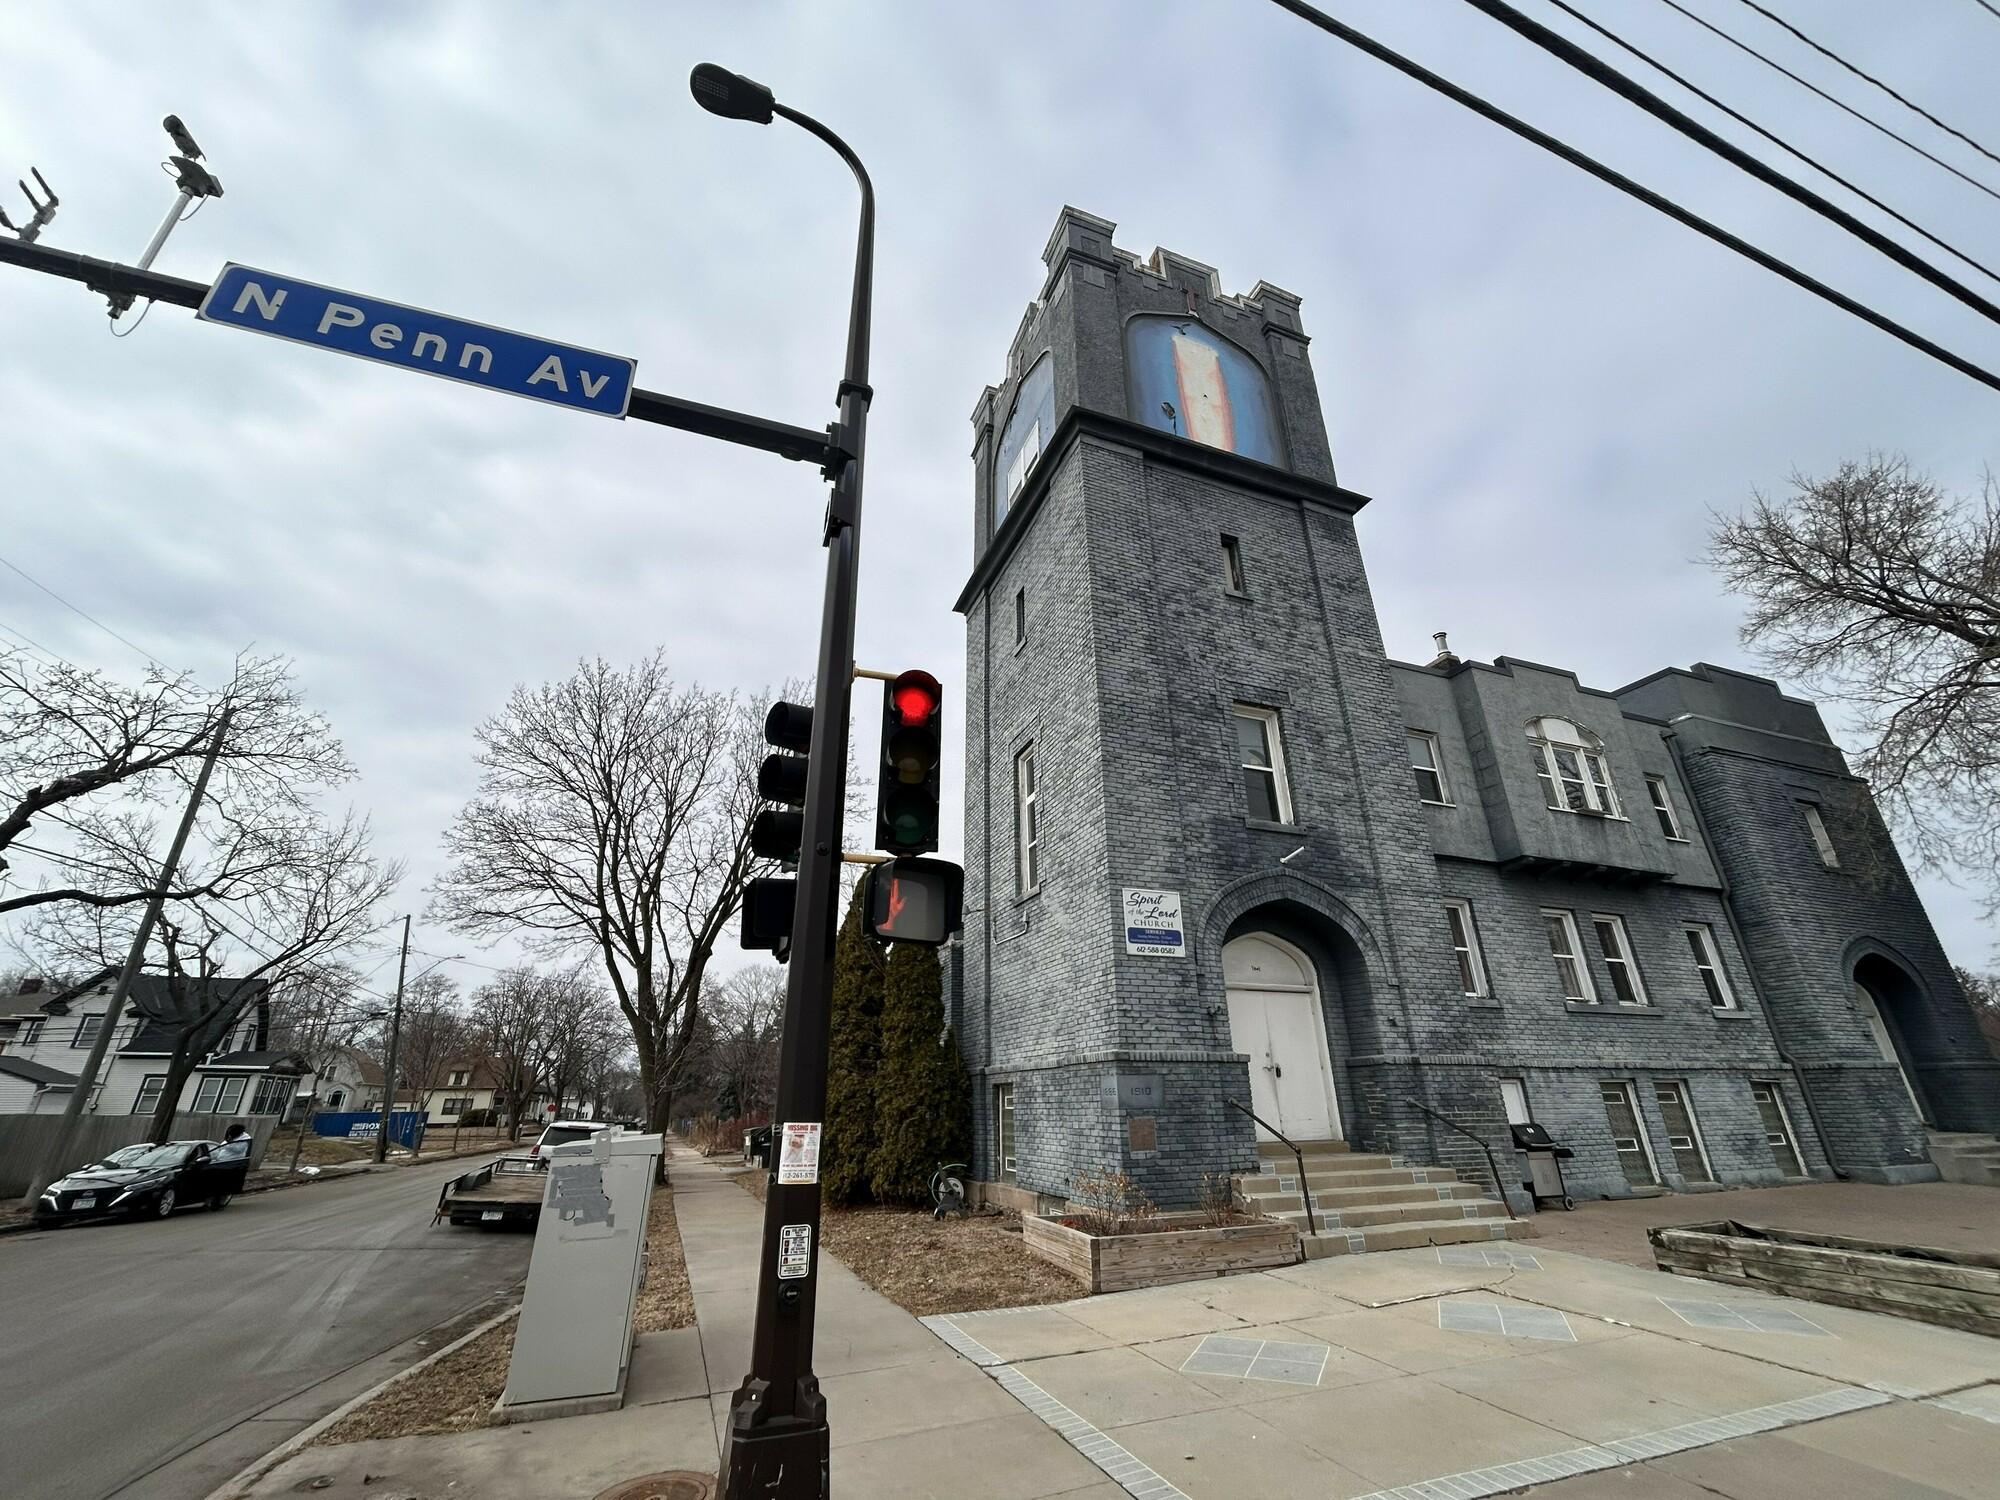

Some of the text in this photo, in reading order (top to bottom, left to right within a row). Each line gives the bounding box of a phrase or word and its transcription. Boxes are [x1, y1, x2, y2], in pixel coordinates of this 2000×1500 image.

[232, 281, 610, 399] N Penn Av
[1126, 892, 1168, 908] Spirit
[1144, 907, 1178, 919] Lord
[1133, 919, 1174, 928] CHURCH
